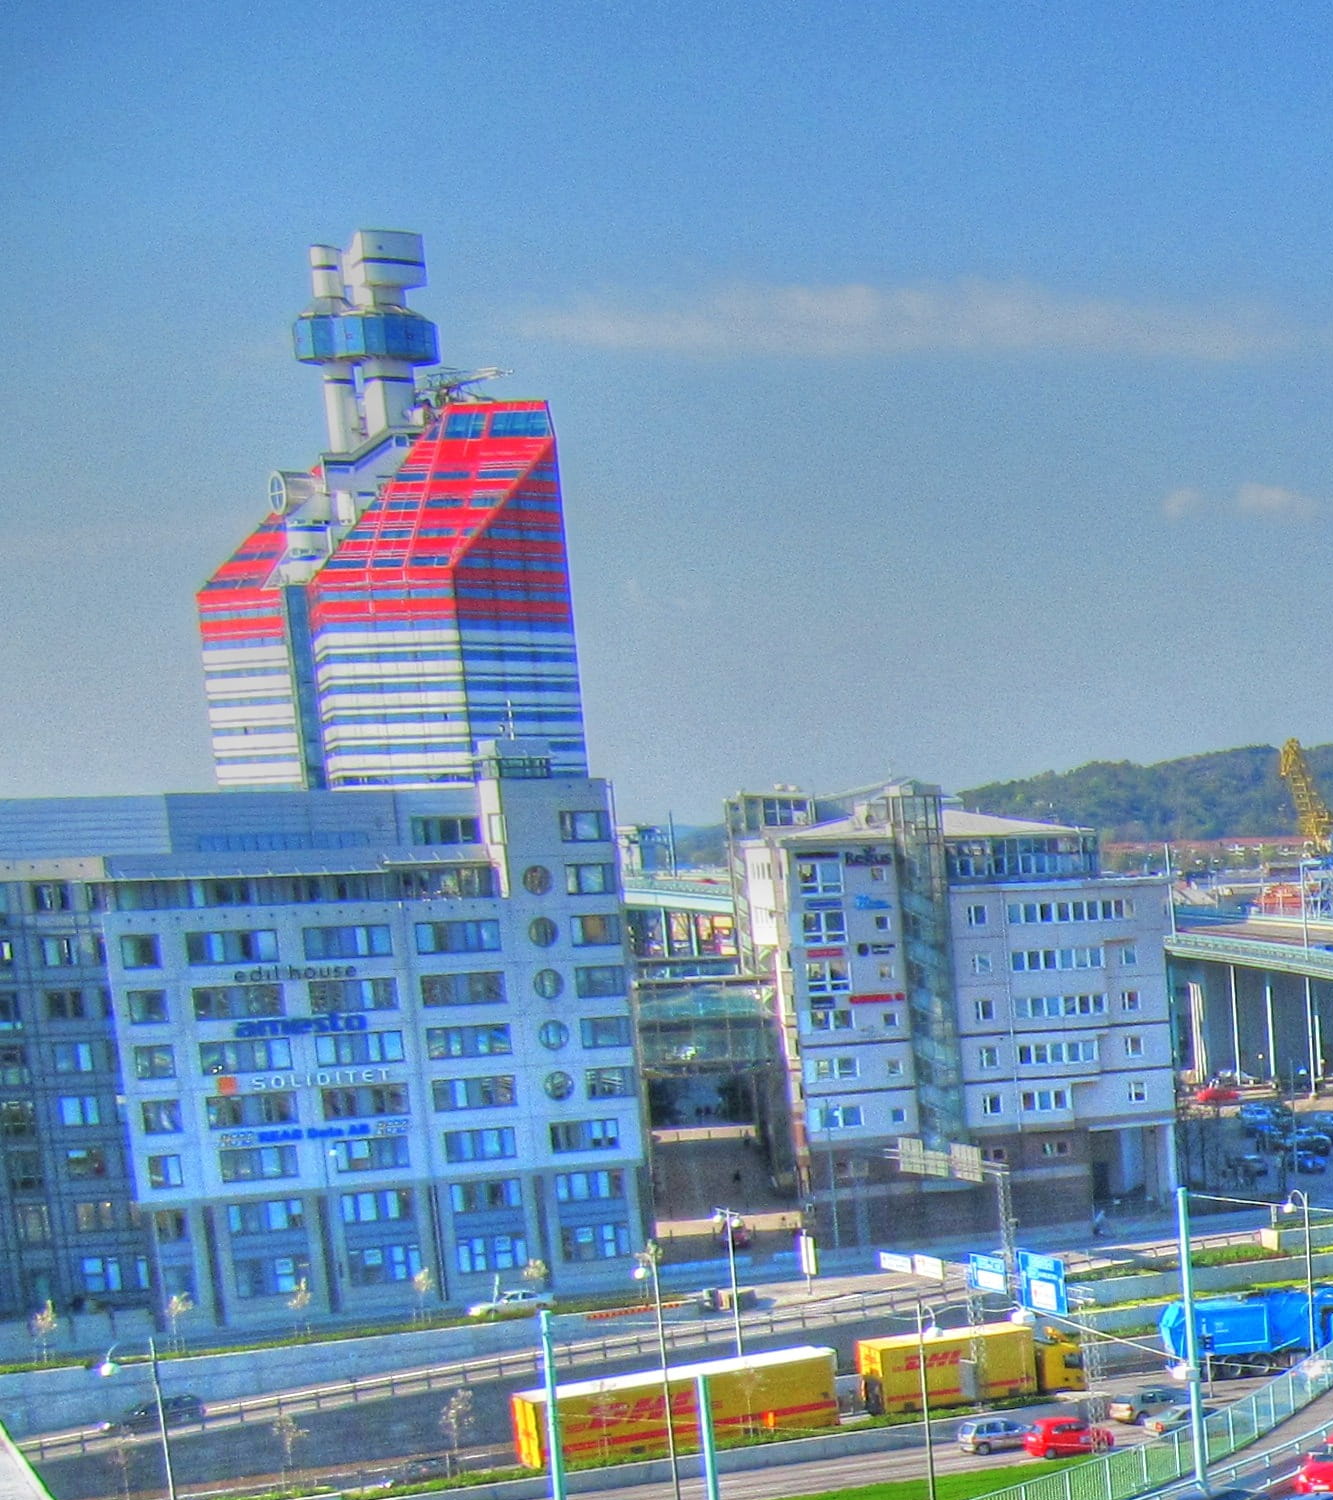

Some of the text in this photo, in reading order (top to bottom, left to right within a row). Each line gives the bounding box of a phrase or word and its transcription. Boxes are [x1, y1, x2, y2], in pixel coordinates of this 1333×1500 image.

[289, 965, 357, 981] house
[252, 1068, 391, 1090] SOLIDITET
[905, 1349, 962, 1370] DHL
